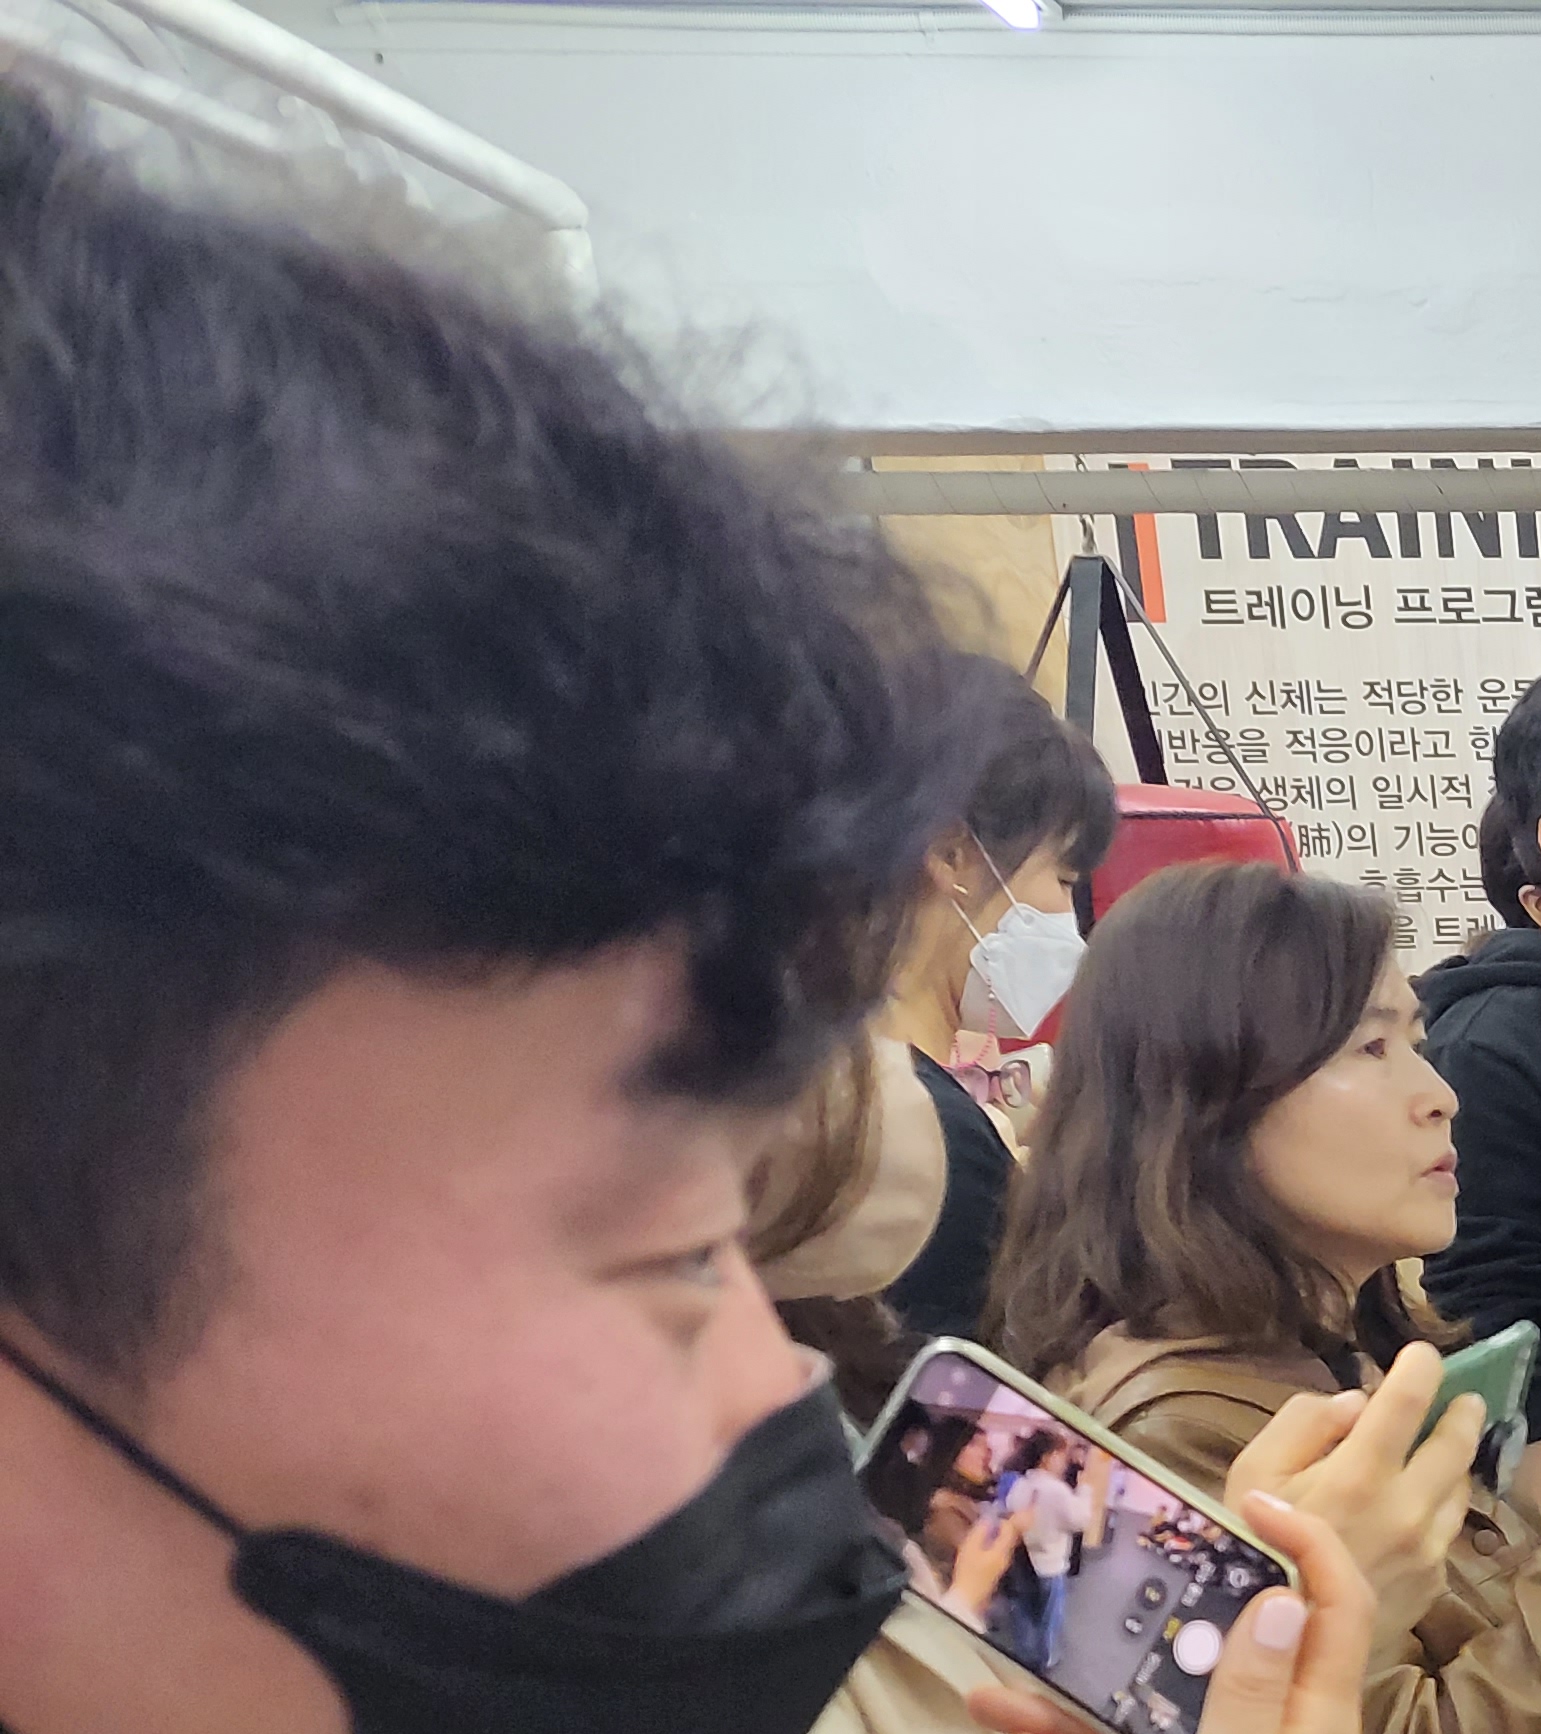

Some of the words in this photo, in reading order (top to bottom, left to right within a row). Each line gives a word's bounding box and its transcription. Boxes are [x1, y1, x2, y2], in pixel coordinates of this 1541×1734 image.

[1200, 584, 1374, 630] 트레이닝
[1244, 679, 1348, 717] 신체는
[1361, 679, 1464, 715] 적당한
[1285, 727, 1457, 764] 적응이라고
[1259, 775, 1358, 812] 생체의
[1373, 774, 1472, 810] 일시적
